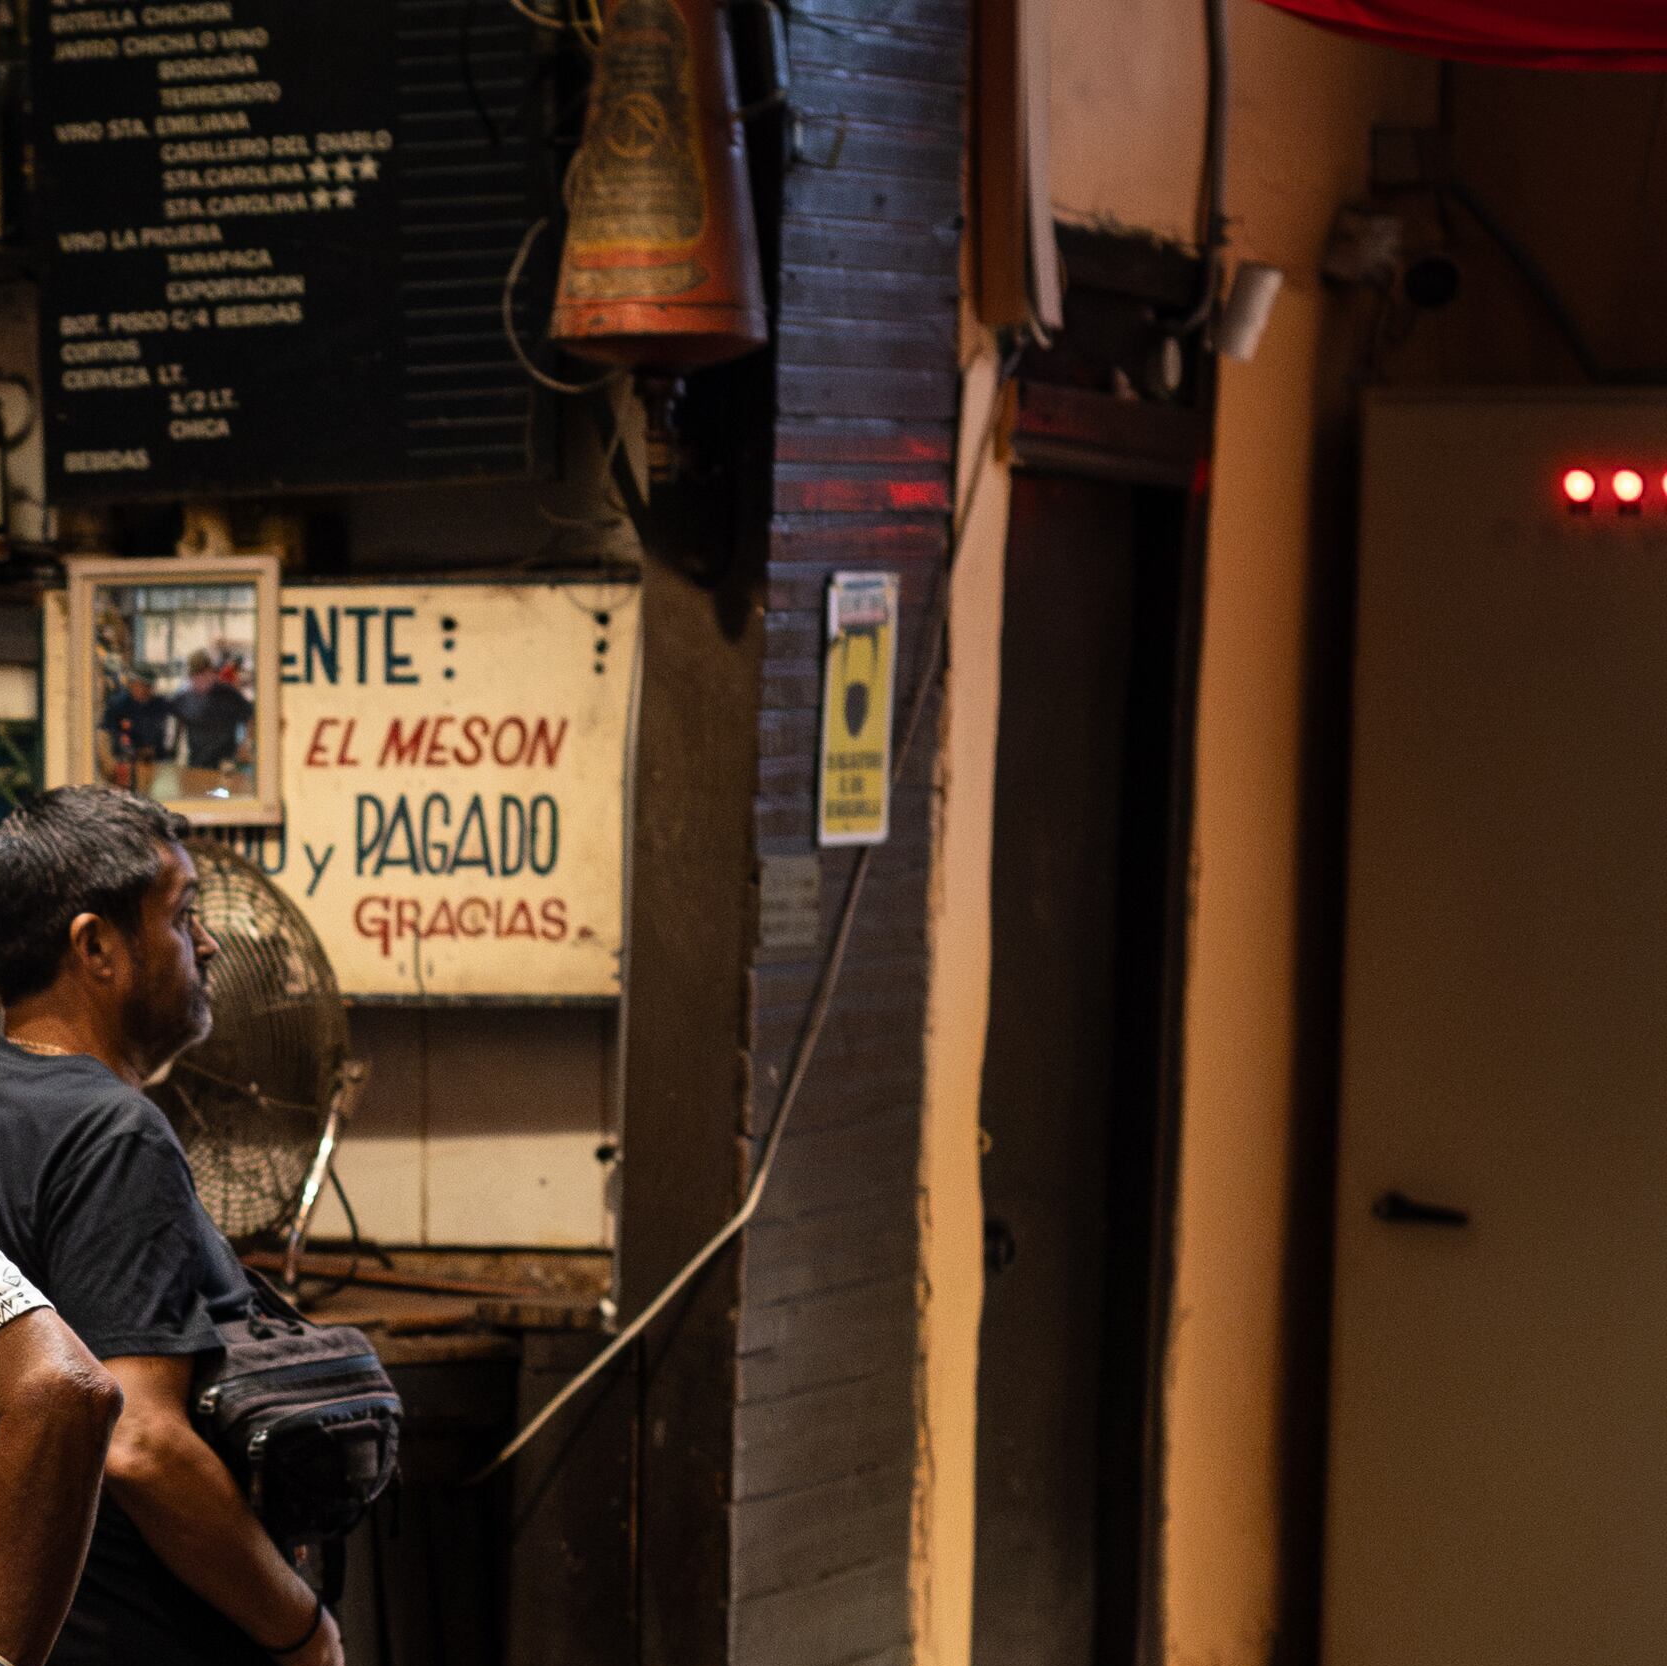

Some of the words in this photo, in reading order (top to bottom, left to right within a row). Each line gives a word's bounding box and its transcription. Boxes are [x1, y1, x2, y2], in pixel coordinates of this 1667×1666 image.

[160, 135, 269, 165] CASILLERO
[270, 133, 312, 158] DEL
[110, 227, 138, 250] LA
[305, 717, 360, 768] EL
[377, 715, 568, 768] MESON
[355, 793, 559, 877] PAGADO
[354, 896, 569, 957] GRACIAS
